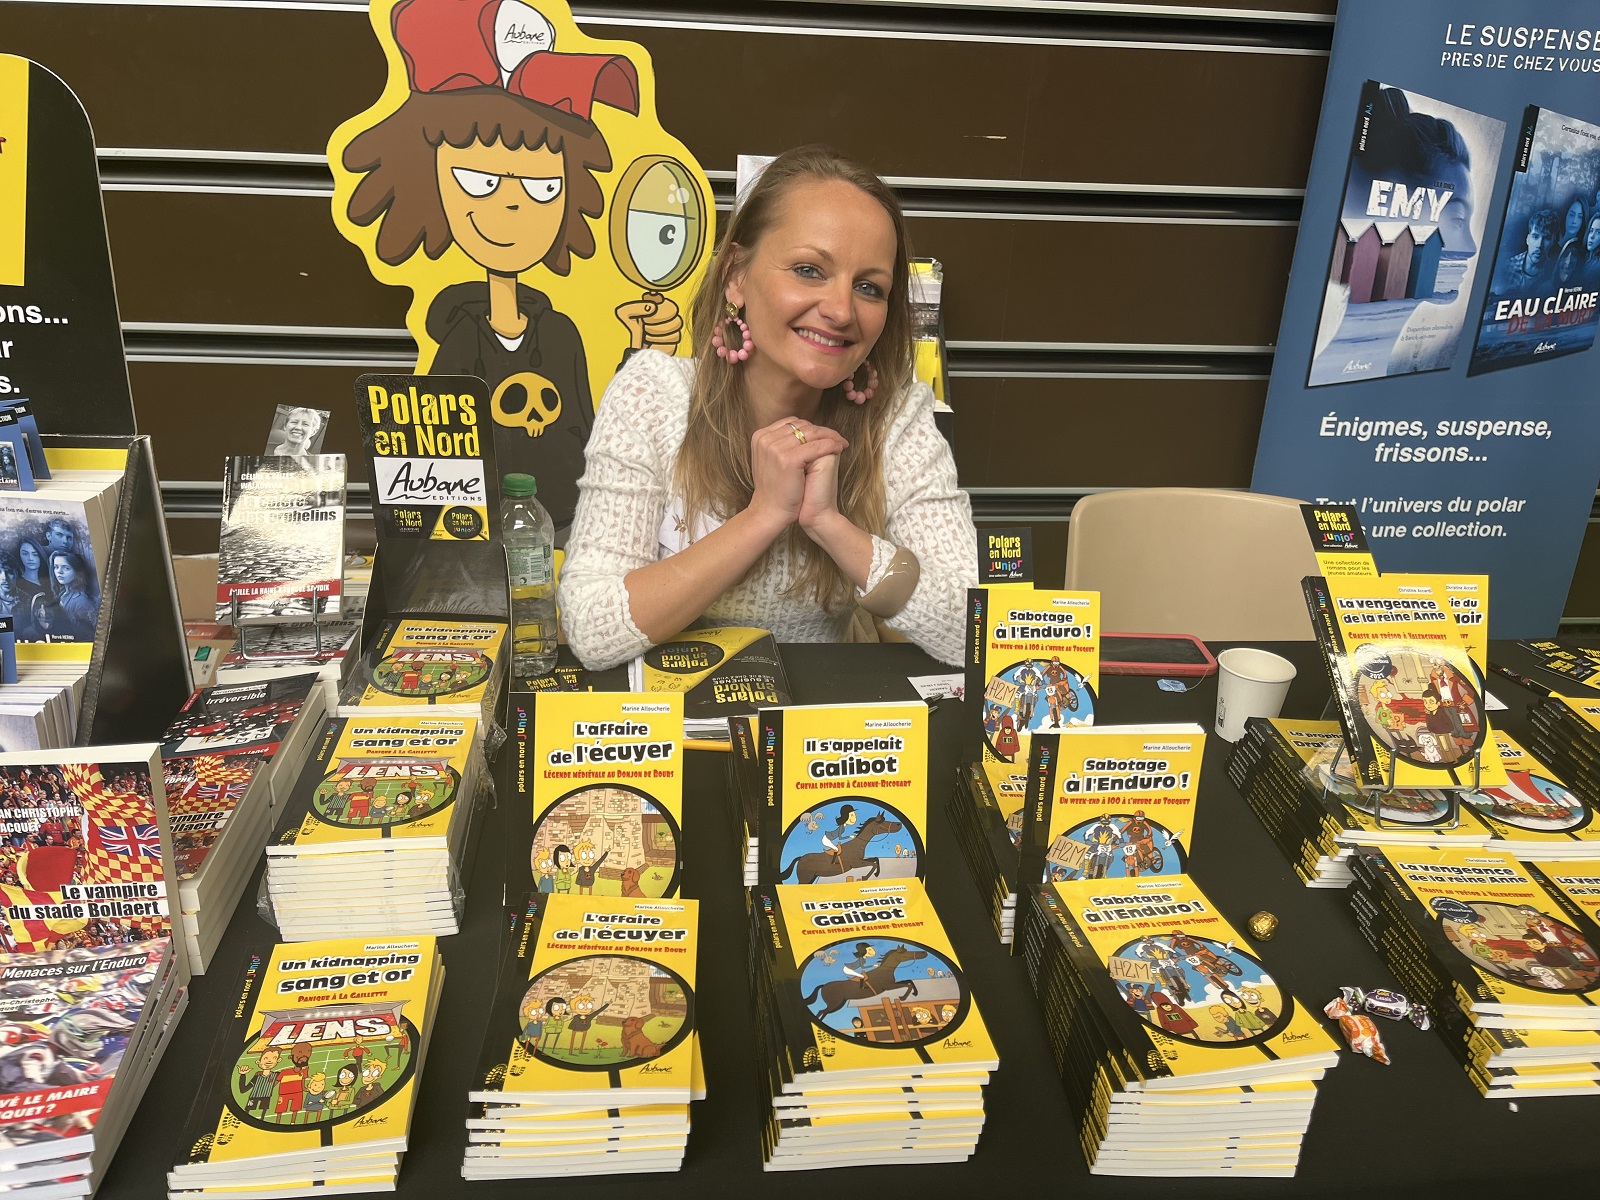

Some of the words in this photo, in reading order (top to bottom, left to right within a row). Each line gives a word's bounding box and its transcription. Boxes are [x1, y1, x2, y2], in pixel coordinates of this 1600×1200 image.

[1445, 24, 1475, 46] LE
[1480, 25, 1600, 51] SUSPENSE
[1441, 52, 1483, 68] PRES
[1486, 54, 1507, 69] DE
[1514, 55, 1554, 72] CHEZ
[1559, 57, 1600, 73] VOUS
[1366, 179, 1454, 222] EMY
[1495, 299, 1541, 320] EAU
[1543, 288, 1599, 315] CLAIRE
[1507, 316, 1529, 335] DE
[1534, 313, 1551, 332] LA
[1557, 308, 1594, 328] MORT
[367, 385, 476, 426] Polars
[1319, 412, 1428, 441] Énigmes,
[1436, 417, 1552, 441] suspense,
[374, 430, 408, 455] en
[415, 425, 481, 457] Nord
[1374, 443, 1488, 464] frissons...
[387, 461, 481, 496] Aubane
[1314, 510, 1348, 521] Polars
[1361, 497, 1442, 513] l'univers
[1447, 497, 1471, 513] du
[1476, 497, 1525, 518] polar
[451, 512, 473, 520] Polars
[1318, 522, 1329, 530] en
[1331, 521, 1351, 530] Nord
[1372, 523, 1406, 538] une
[1412, 521, 1507, 538] collection.
[989, 535, 1020, 548] Polars
[989, 549, 999, 558] en
[1002, 547, 1021, 558] Nord
[1339, 600, 1354, 609] La
[1355, 600, 1436, 611] vengeance
[1465, 599, 1477, 608] du
[1010, 611, 1072, 623] Sabotage
[1344, 614, 1360, 623] de
[1362, 613, 1375, 623] la
[1377, 612, 1410, 622] reine
[1414, 611, 1446, 621] Anne
[405, 634, 448, 642] sang
[452, 633, 471, 641] et
[425, 626, 497, 636] kidnapping
[996, 623, 1007, 639] à
[1010, 625, 1081, 638] l'Enduro
[1086, 625, 1091, 638] !
[398, 651, 476, 663] LENS
[662, 658, 709, 669] Polars
[713, 683, 750, 696] Nord
[715, 690, 778, 704] Polars
[990, 681, 1015, 703] H2M
[206, 691, 266, 705] Irréversible
[376, 727, 464, 737] kidnapping
[576, 722, 648, 736] L'affaire
[353, 737, 404, 748] sang
[409, 737, 432, 746] et
[435, 737, 458, 746] or
[806, 741, 816, 752] Il
[820, 737, 902, 753] s'appelait
[550, 752, 572, 764] de
[576, 740, 672, 762] l'écuyer
[343, 765, 439, 779] LENS
[767, 758, 775, 772] nord
[811, 756, 896, 778] Galibot
[1086, 760, 1167, 772] Sabotage
[518, 770, 526, 793] polars
[1066, 774, 1080, 792] à
[1085, 775, 1176, 792] l'Enduro
[1182, 774, 1189, 788] !
[767, 784, 775, 807] polars
[14, 806, 80, 819] CHRISTOPHE
[1052, 840, 1086, 865] H2M
[1400, 863, 1416, 871] La
[1417, 864, 1513, 877] vengeance
[1409, 873, 1427, 882] de
[1431, 874, 1445, 882] la
[1448, 875, 1485, 884] reine
[1488, 876, 1528, 884] Anne
[61, 885, 80, 900] Le
[85, 882, 158, 901] vampire
[805, 902, 816, 910] Il
[819, 897, 904, 910] s'appelait
[1093, 893, 1172, 907] Sabotage
[9, 905, 31, 920] du
[35, 903, 84, 919] stade
[88, 901, 160, 917] Bollaert
[814, 908, 904, 927] Galibot
[1086, 907, 1098, 922] à
[1106, 904, 1191, 921] l'Enduro
[586, 914, 661, 925] L'affaire
[556, 931, 579, 939] de
[583, 926, 686, 942] l'écuyer
[1, 966, 63, 980] Menaces
[66, 962, 87, 975] sur
[92, 956, 147, 972] l'Enduro
[281, 961, 306, 971] Un
[310, 953, 419, 970] kidnapping
[1113, 959, 1149, 980] H2M
[279, 976, 346, 994] sang
[352, 971, 378, 985] et
[384, 967, 412, 982] or
[235, 998, 248, 1018] polars
[269, 1016, 391, 1046] LENS
[23, 1094, 41, 1105] LE
[46, 1085, 99, 1102] MAIRE
[46, 1104, 56, 1114] ?
